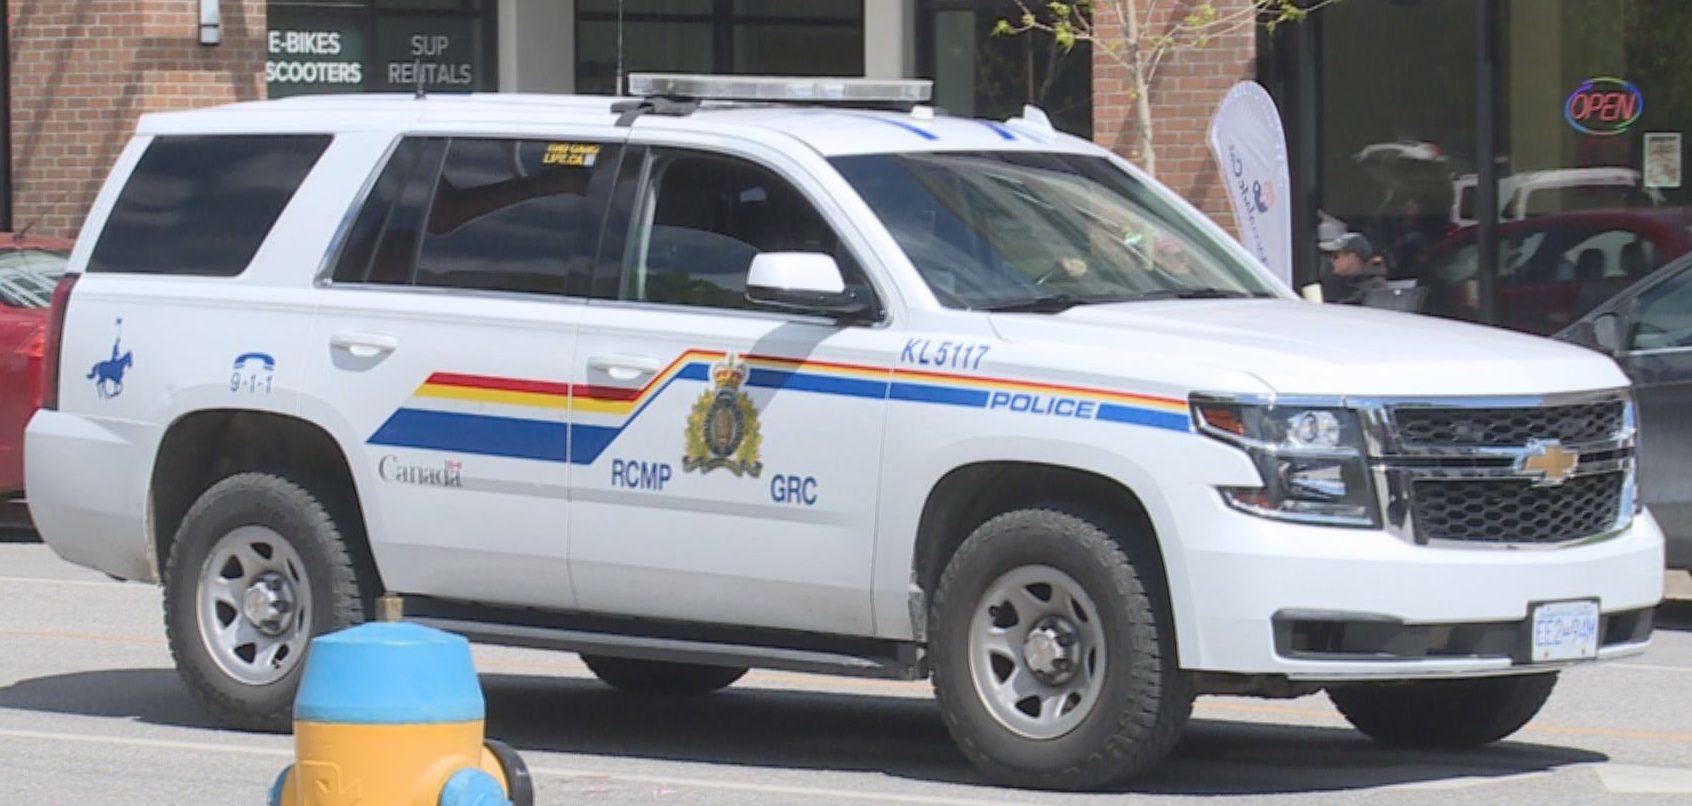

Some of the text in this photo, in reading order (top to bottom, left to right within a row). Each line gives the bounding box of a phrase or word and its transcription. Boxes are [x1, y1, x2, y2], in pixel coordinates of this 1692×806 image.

[268, 31, 341, 55] E-BIKES
[411, 35, 449, 56] SUP
[265, 61, 363, 84] SCOOTERS
[1570, 91, 1637, 121] OPEN
[900, 337, 991, 370] KL5117
[230, 371, 273, 394] 9-1-1
[989, 391, 1096, 419] POLICE
[378, 454, 464, 488] Canada
[611, 458, 672, 491] RCMP
[770, 474, 818, 506] GRC
